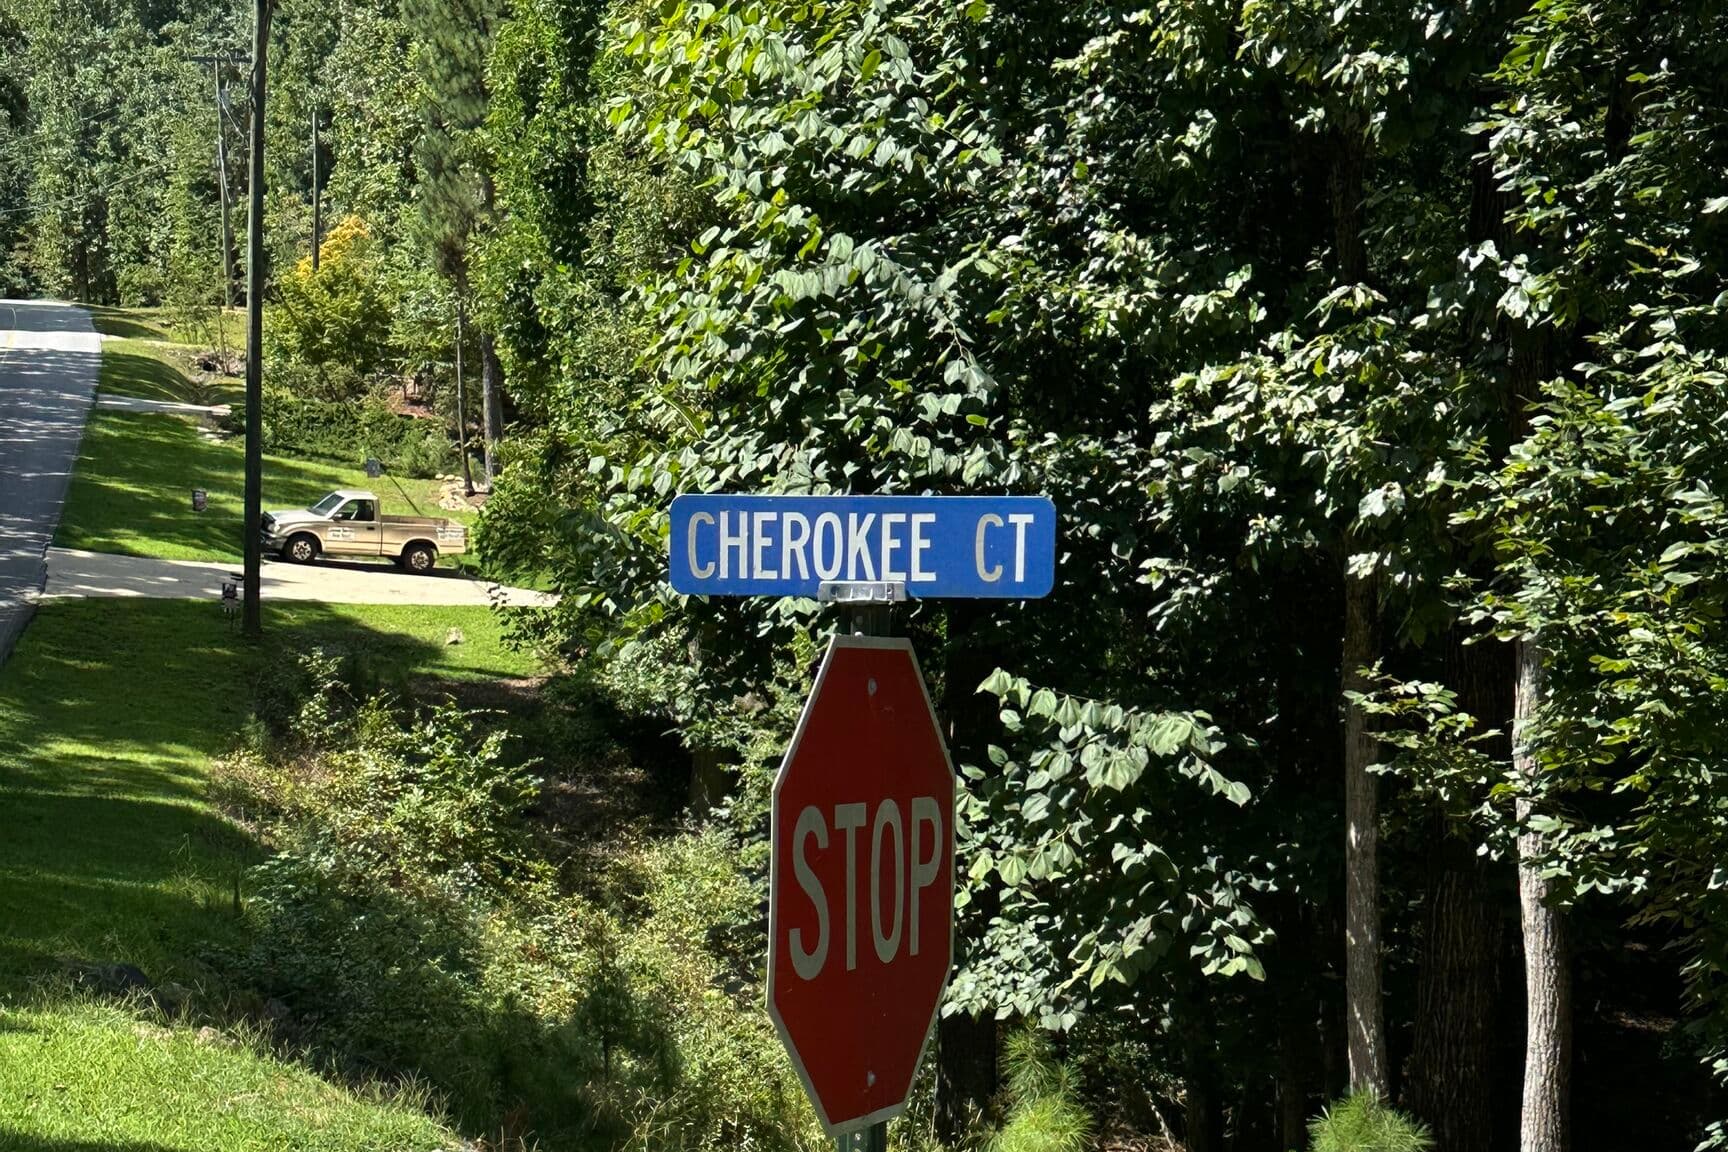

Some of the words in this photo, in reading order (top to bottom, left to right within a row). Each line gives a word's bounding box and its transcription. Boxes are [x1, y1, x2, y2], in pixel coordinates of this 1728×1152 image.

[687, 510, 937, 582] CHEROKEE
[975, 513, 1034, 583] CT
[789, 796, 943, 981] STOP
